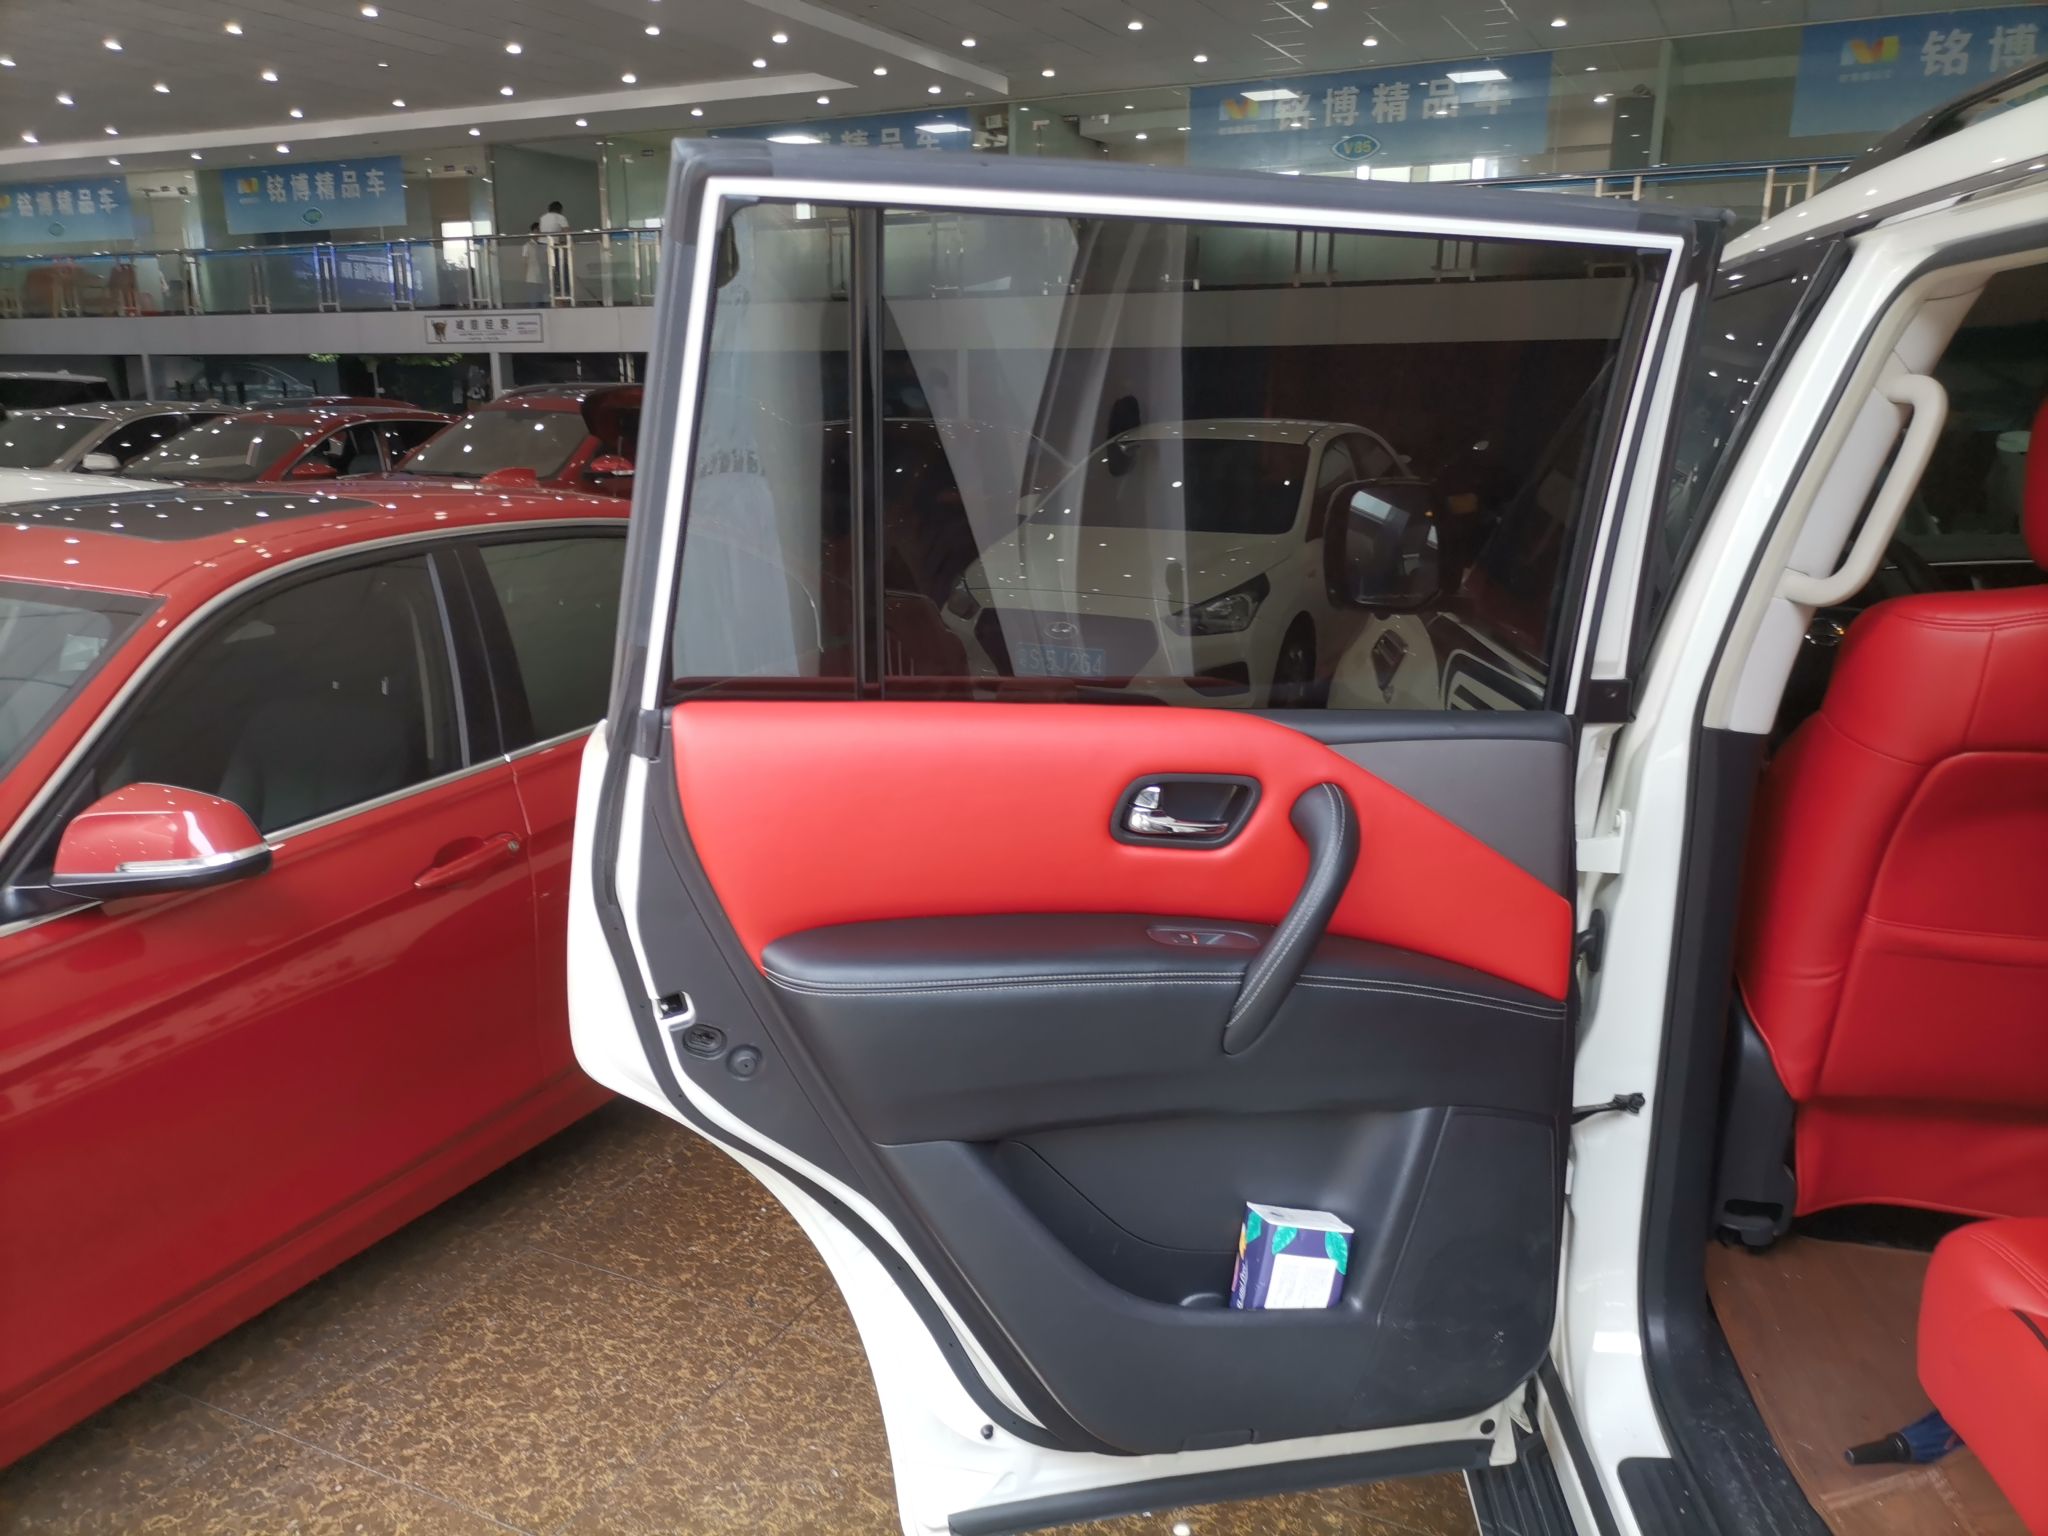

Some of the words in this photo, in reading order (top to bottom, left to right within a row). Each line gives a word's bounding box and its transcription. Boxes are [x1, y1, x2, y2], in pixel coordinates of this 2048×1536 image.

[1920, 23, 2040, 77] 铭博
[266, 168, 386, 203] 铭博精品车
